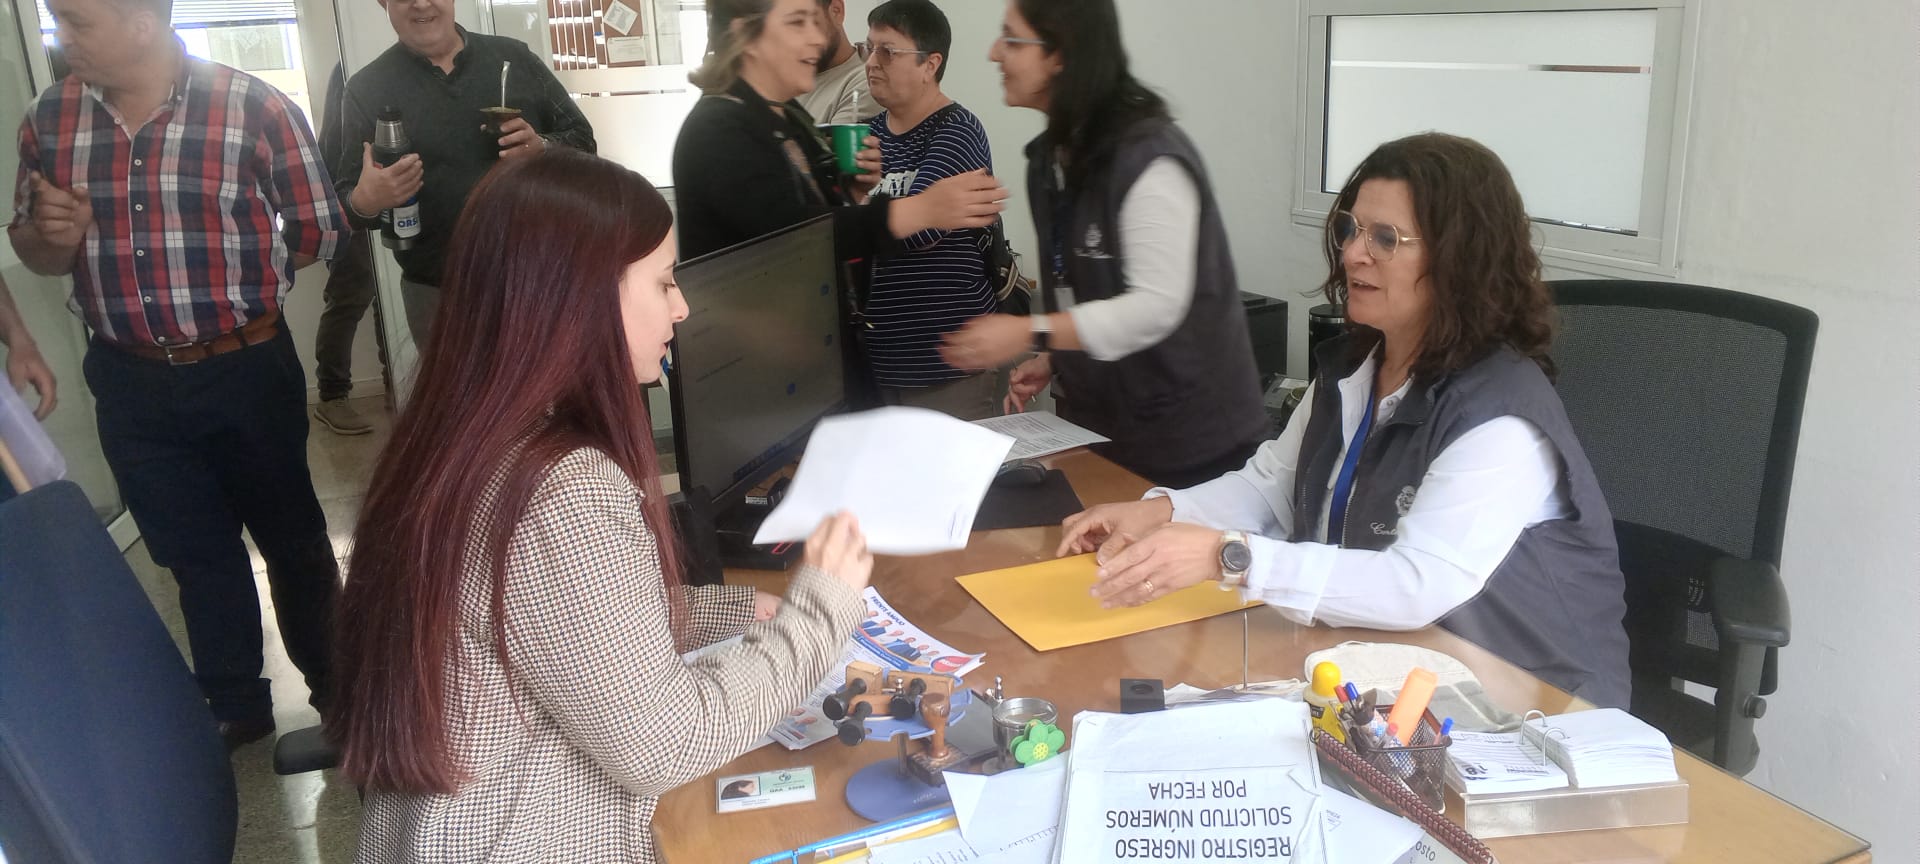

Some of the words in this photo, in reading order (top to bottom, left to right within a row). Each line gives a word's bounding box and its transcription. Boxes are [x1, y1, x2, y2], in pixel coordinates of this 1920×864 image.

[1148, 781, 1205, 800] FECHA
[1211, 779, 1247, 799] POR
[1106, 809, 1194, 833] NÚMEROS
[1200, 806, 1292, 828] SOLICITUD
[1115, 838, 1195, 859] INGRESO
[1202, 836, 1292, 858] REGISTRO
